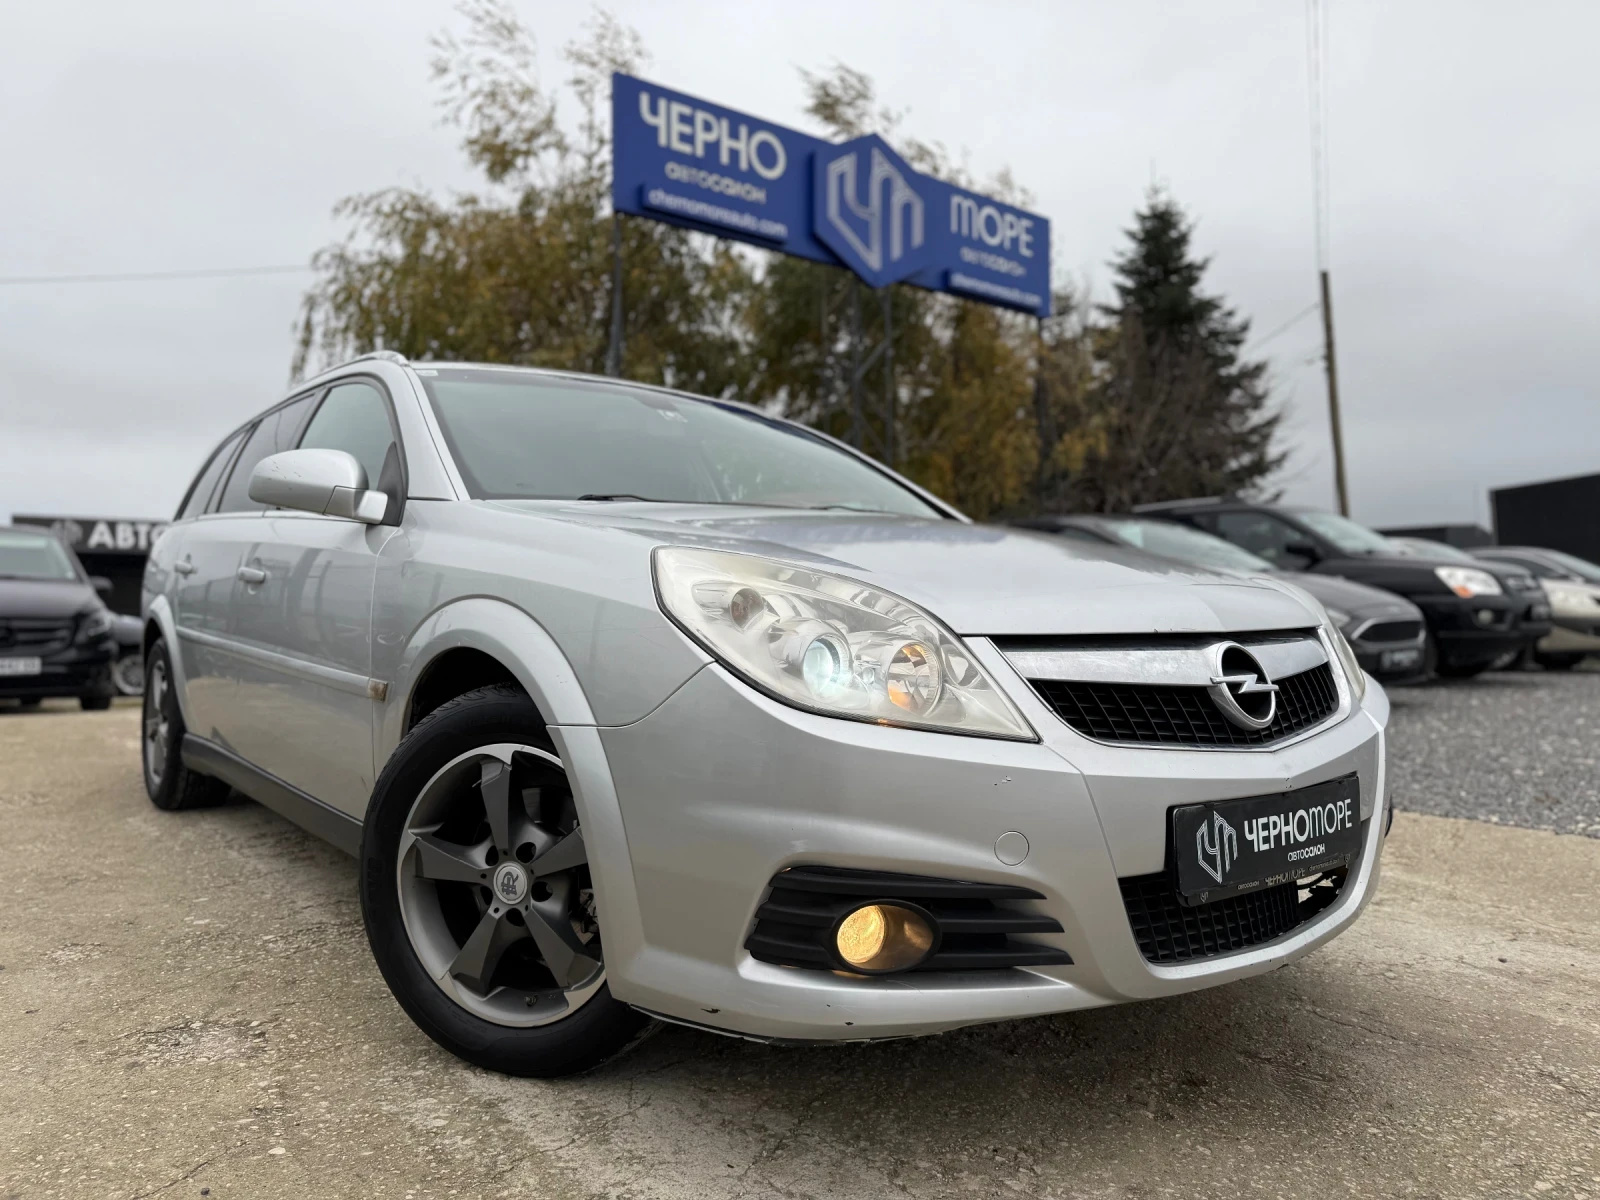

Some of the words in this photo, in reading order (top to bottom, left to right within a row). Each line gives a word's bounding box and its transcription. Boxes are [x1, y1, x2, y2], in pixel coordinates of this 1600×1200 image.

[639, 91, 787, 180] ЧЕРНО
[1244, 798, 1352, 852] ЧЕРНОМОРЕ
[1287, 843, 1325, 861] автосалон
